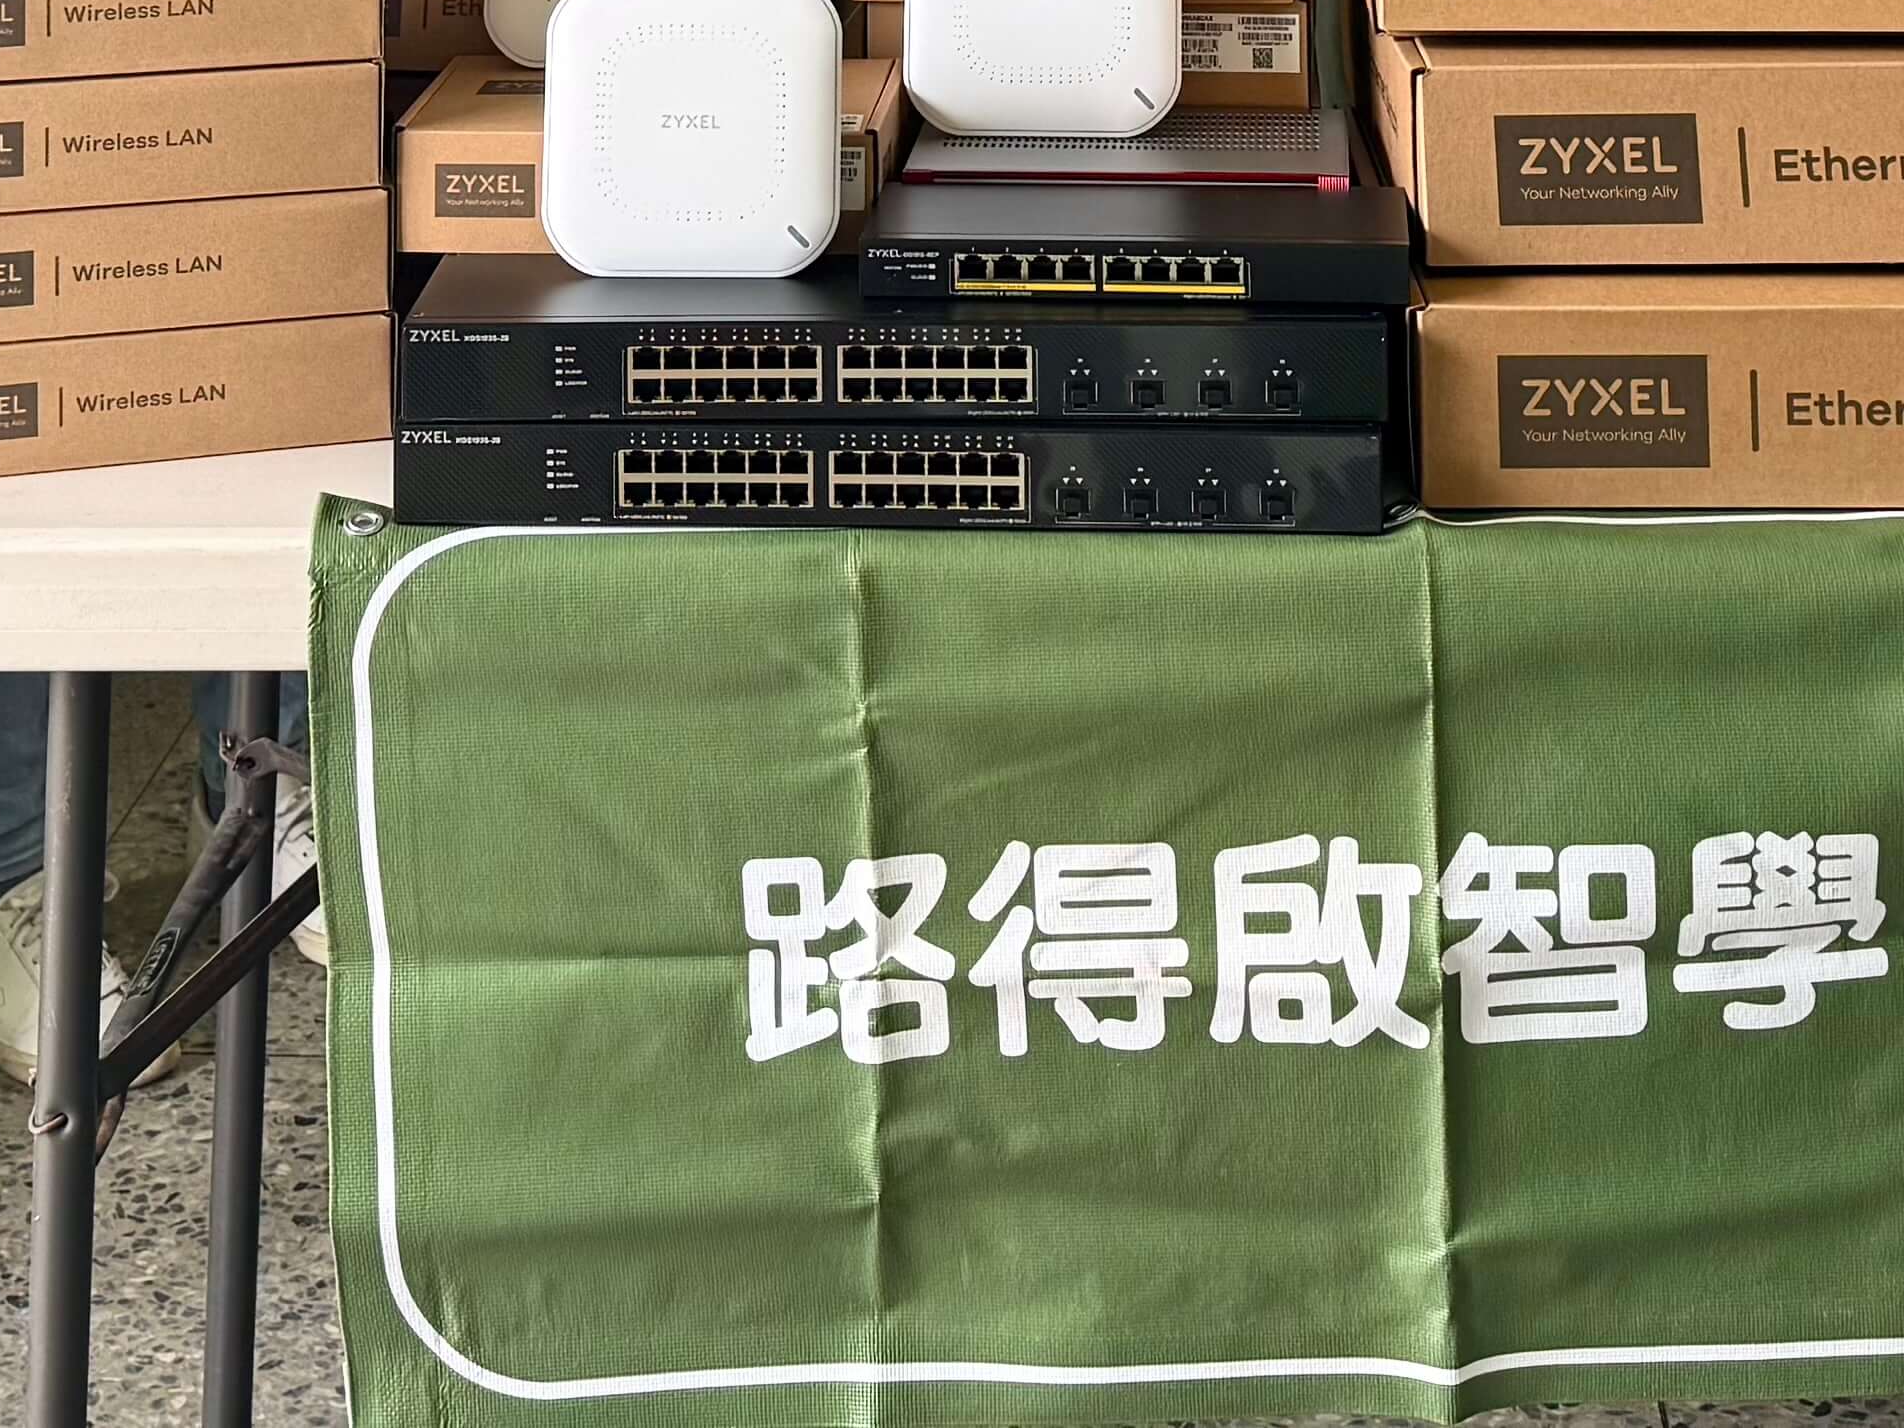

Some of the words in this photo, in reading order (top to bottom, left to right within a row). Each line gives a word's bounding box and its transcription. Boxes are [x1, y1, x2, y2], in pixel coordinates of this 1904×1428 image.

[64, 2, 161, 23] Wireless
[661, 113, 722, 130] ZYXEL
[62, 132, 160, 154] Wireless
[165, 127, 213, 148] LAN
[1517, 136, 1679, 176] ZYXEL
[446, 173, 525, 195] ZYXEL
[1520, 184, 1554, 201] Your
[1557, 183, 1644, 203] Networking
[1646, 183, 1680, 203] Ally
[72, 259, 170, 282] Wireless
[175, 255, 223, 275] LAN
[409, 330, 461, 342] ZYXEL
[76, 389, 173, 414] Wireless
[179, 383, 226, 405] LAN
[1520, 378, 1687, 417] ZYXEL
[401, 431, 452, 444] ZYXEL
[1521, 426, 1557, 443] Your
[1560, 425, 1650, 445] Networking
[1652, 425, 1687, 445] Ally
